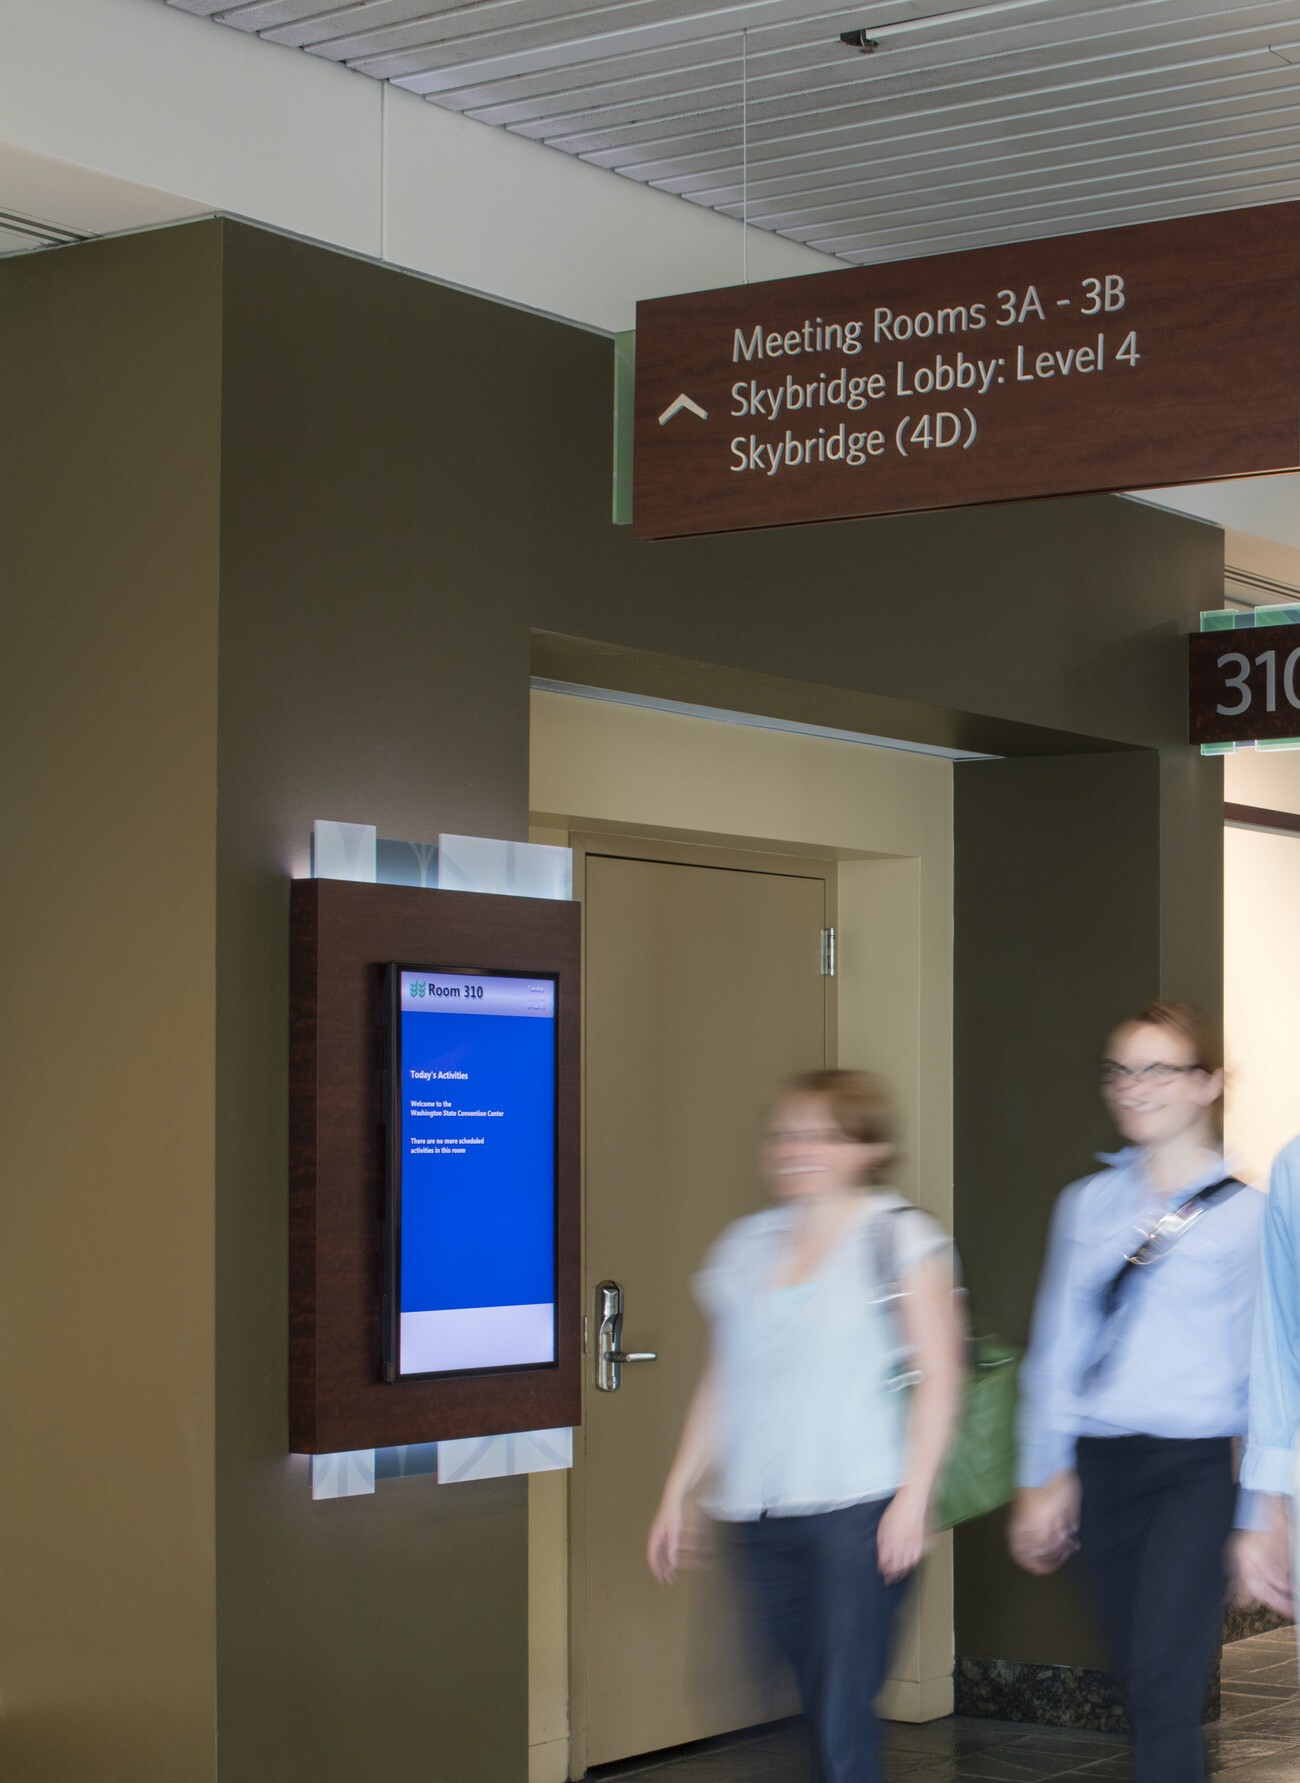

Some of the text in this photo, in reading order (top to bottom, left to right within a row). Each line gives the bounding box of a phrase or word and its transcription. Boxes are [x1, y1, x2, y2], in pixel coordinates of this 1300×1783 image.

[732, 274, 1126, 364] Meeting Rooms 3A - 3B
[730, 330, 1142, 422] Skybridge Lobby: Level 4
[730, 407, 978, 477] Skybridge (4D)
[428, 983, 484, 999] Room 310
[410, 1070, 469, 1081] Today's Activities
[410, 1100, 436, 1108] Welcome
[442, 1100, 452, 1108] the
[410, 1109, 442, 1118] Washington
[443, 1109, 457, 1117] State
[457, 1109, 487, 1117] Convention
[410, 1137, 426, 1145] There
[458, 1137, 485, 1145] scheduled
[410, 1146, 434, 1154] activities
